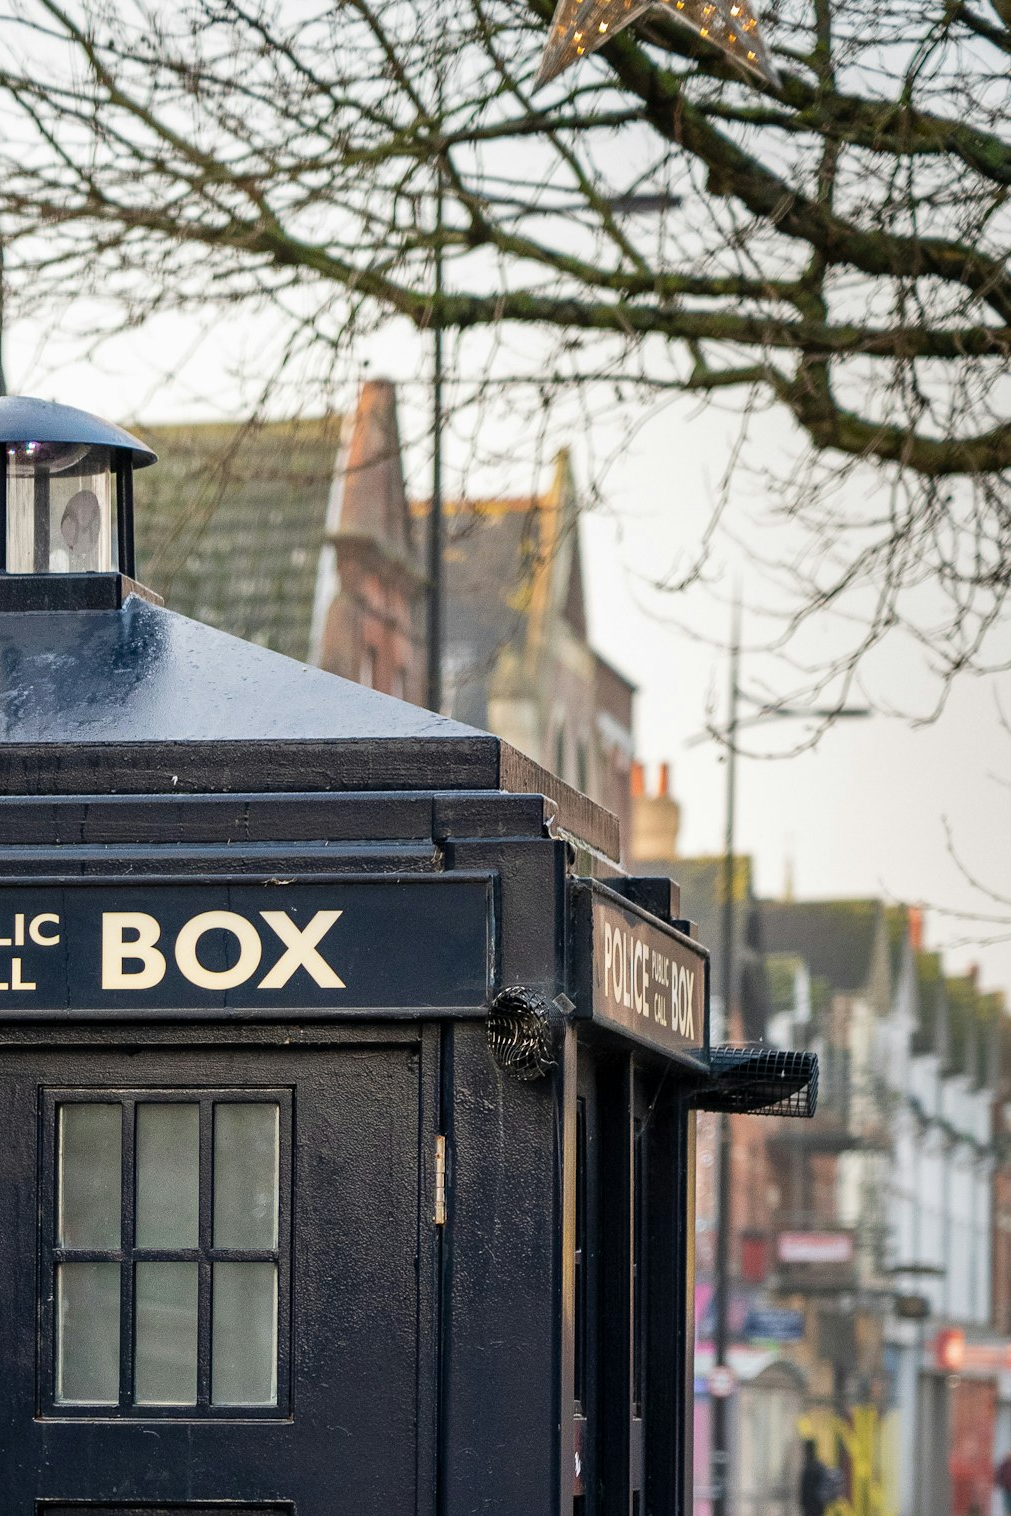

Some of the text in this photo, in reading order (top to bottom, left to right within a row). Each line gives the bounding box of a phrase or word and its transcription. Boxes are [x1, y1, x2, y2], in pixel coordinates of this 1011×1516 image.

[101, 910, 346, 990] BOX
[605, 923, 650, 1018] POLICE
[652, 950, 669, 987] PUBLIC
[654, 993, 667, 1027] CALL
[672, 961, 694, 1041] BOX
